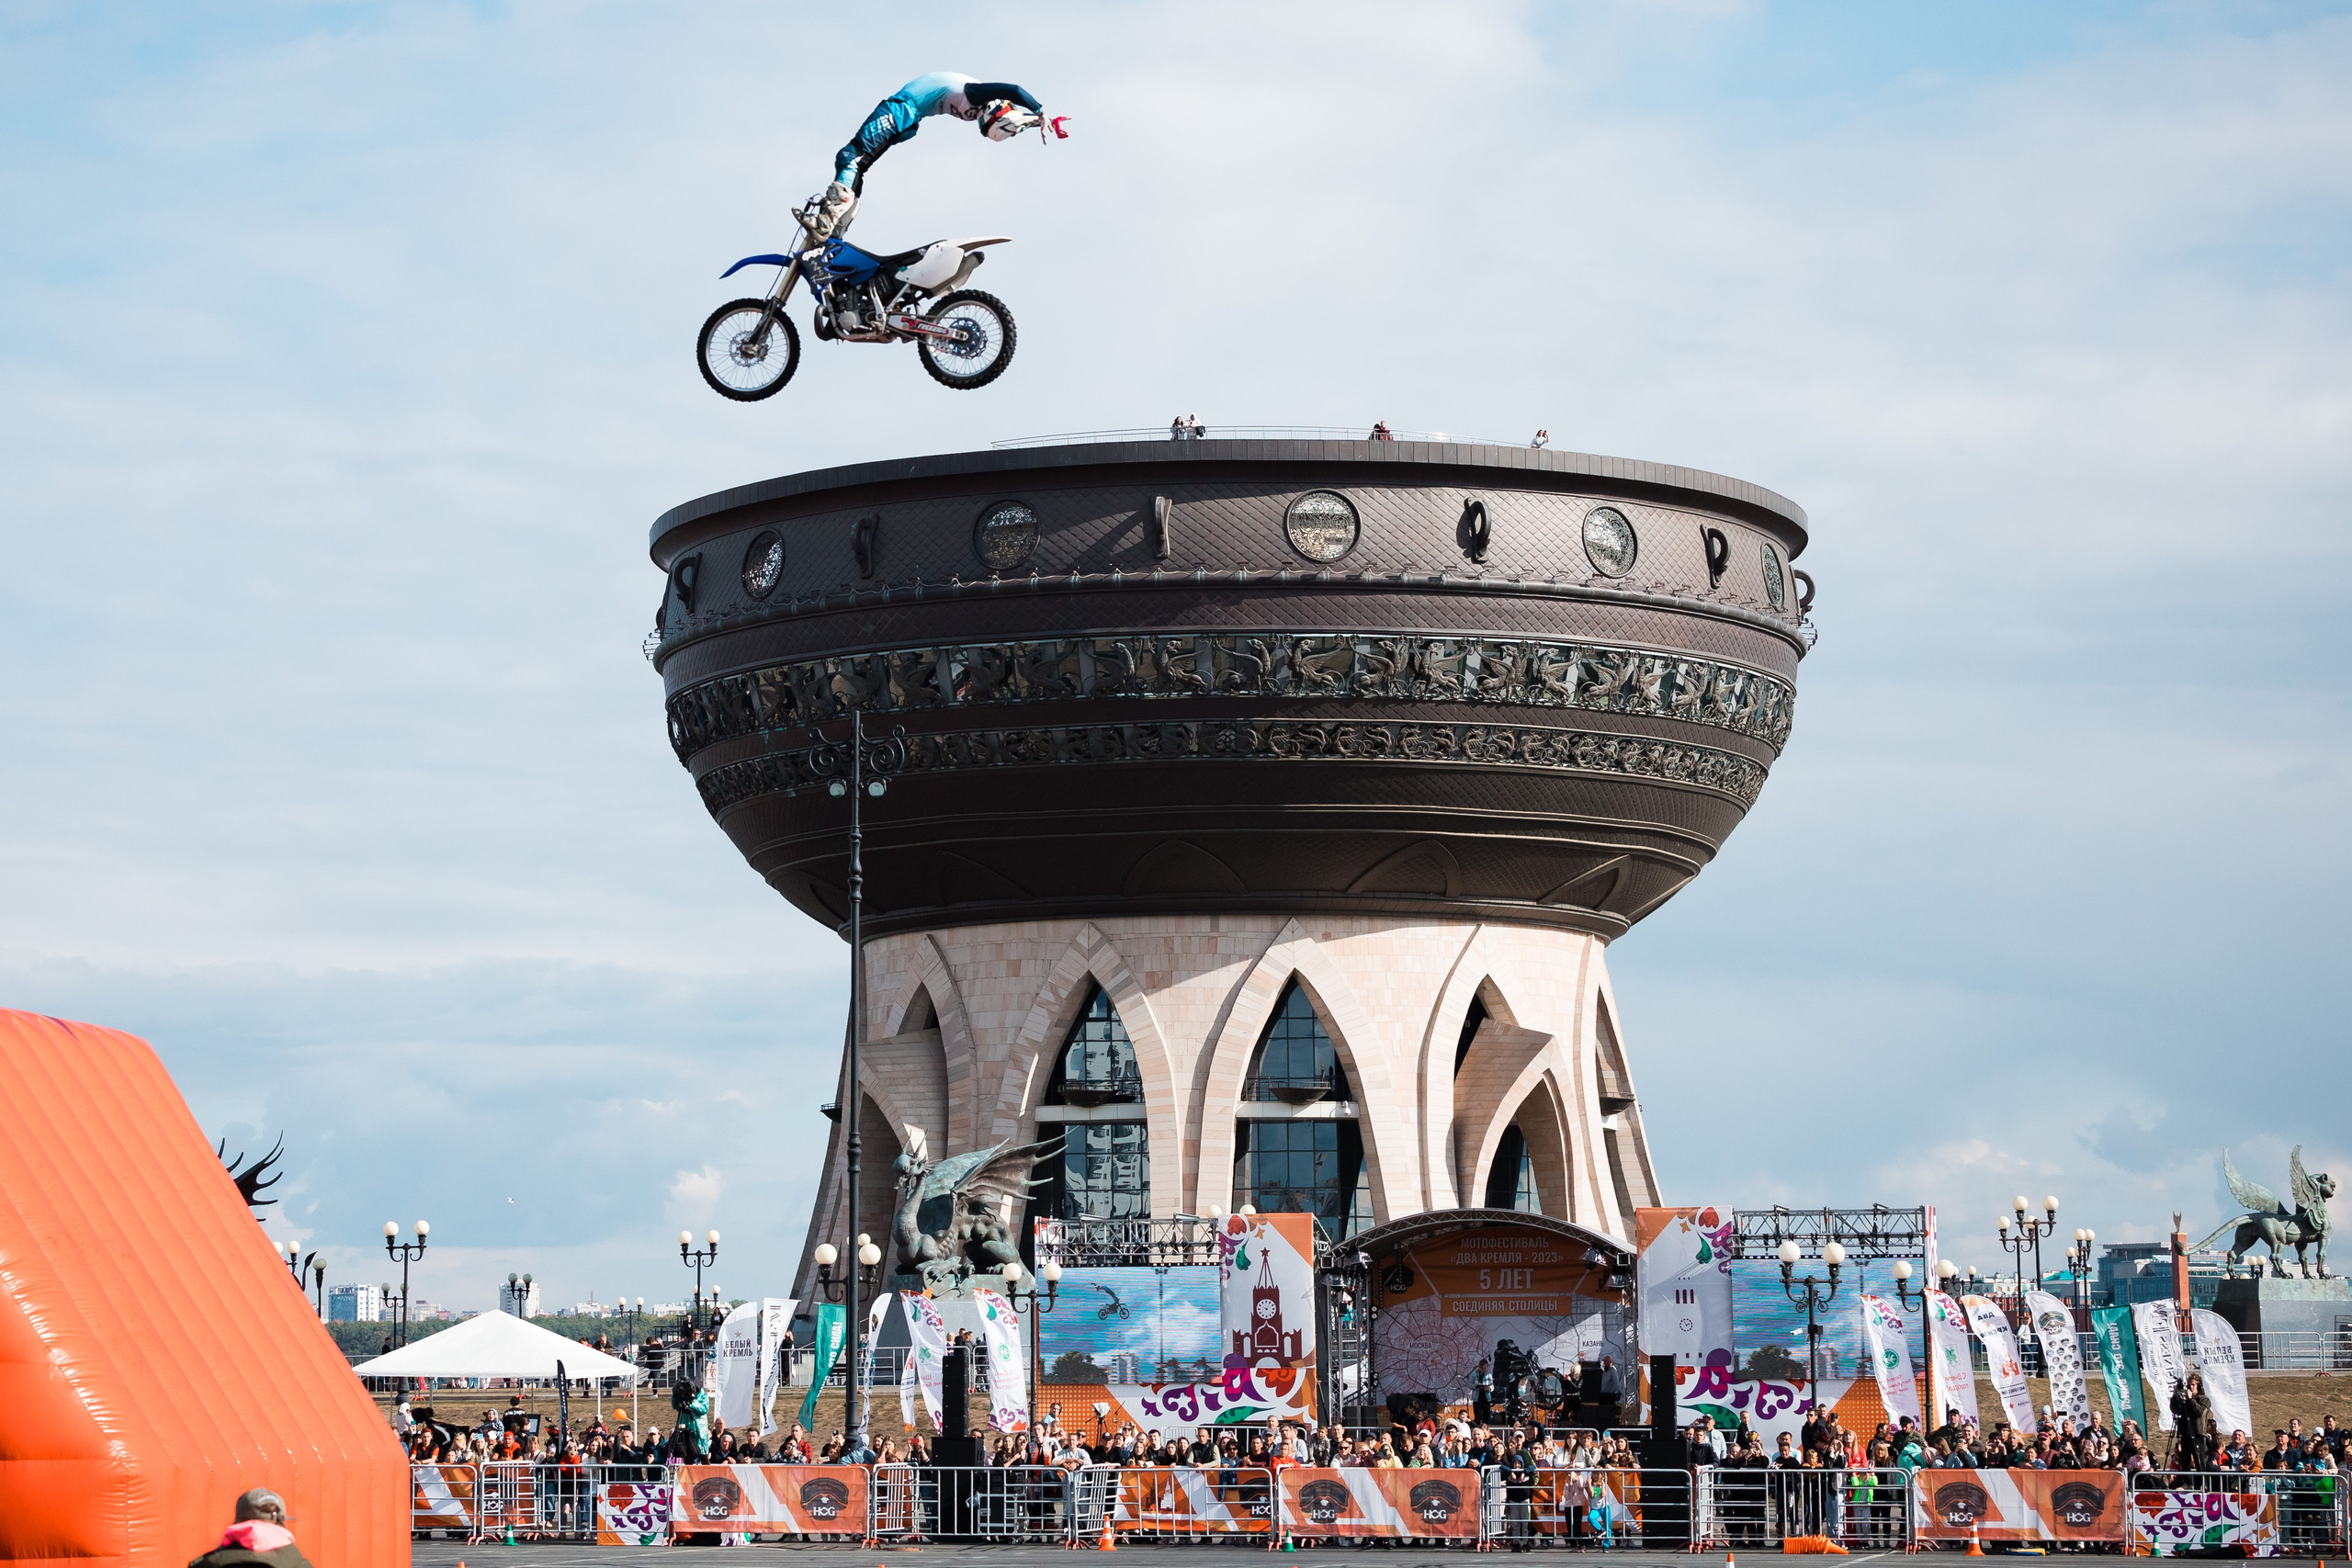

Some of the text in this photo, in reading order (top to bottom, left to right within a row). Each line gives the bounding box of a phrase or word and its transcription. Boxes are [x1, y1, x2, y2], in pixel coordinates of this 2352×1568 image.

[1461, 1237, 1549, 1248] МОТОФЕСТИВАЛЬ
[1451, 1253, 1477, 1265] «ДВА
[1480, 1252, 1522, 1264] КРЕМЛЯ
[1532, 1252, 1564, 1263] 2023»
[1480, 1269, 1533, 1290] 5 ЛЕТ
[1453, 1300, 1557, 1313] СОЕДИНЯЯ СТОЛИЦЫ
[831, 1322, 842, 1349] СИЛА!
[725, 1338, 751, 1348] БЕЛЫЙ
[723, 1348, 752, 1358] КРЕМЛЬ
[705, 1506, 728, 1516] HOG
[813, 1506, 835, 1516] HOG
[1312, 1509, 1335, 1518] HOG
[1424, 1510, 1447, 1519] HOG
[1950, 1512, 1973, 1522] HOG
[2066, 1513, 2091, 1522] HOG
